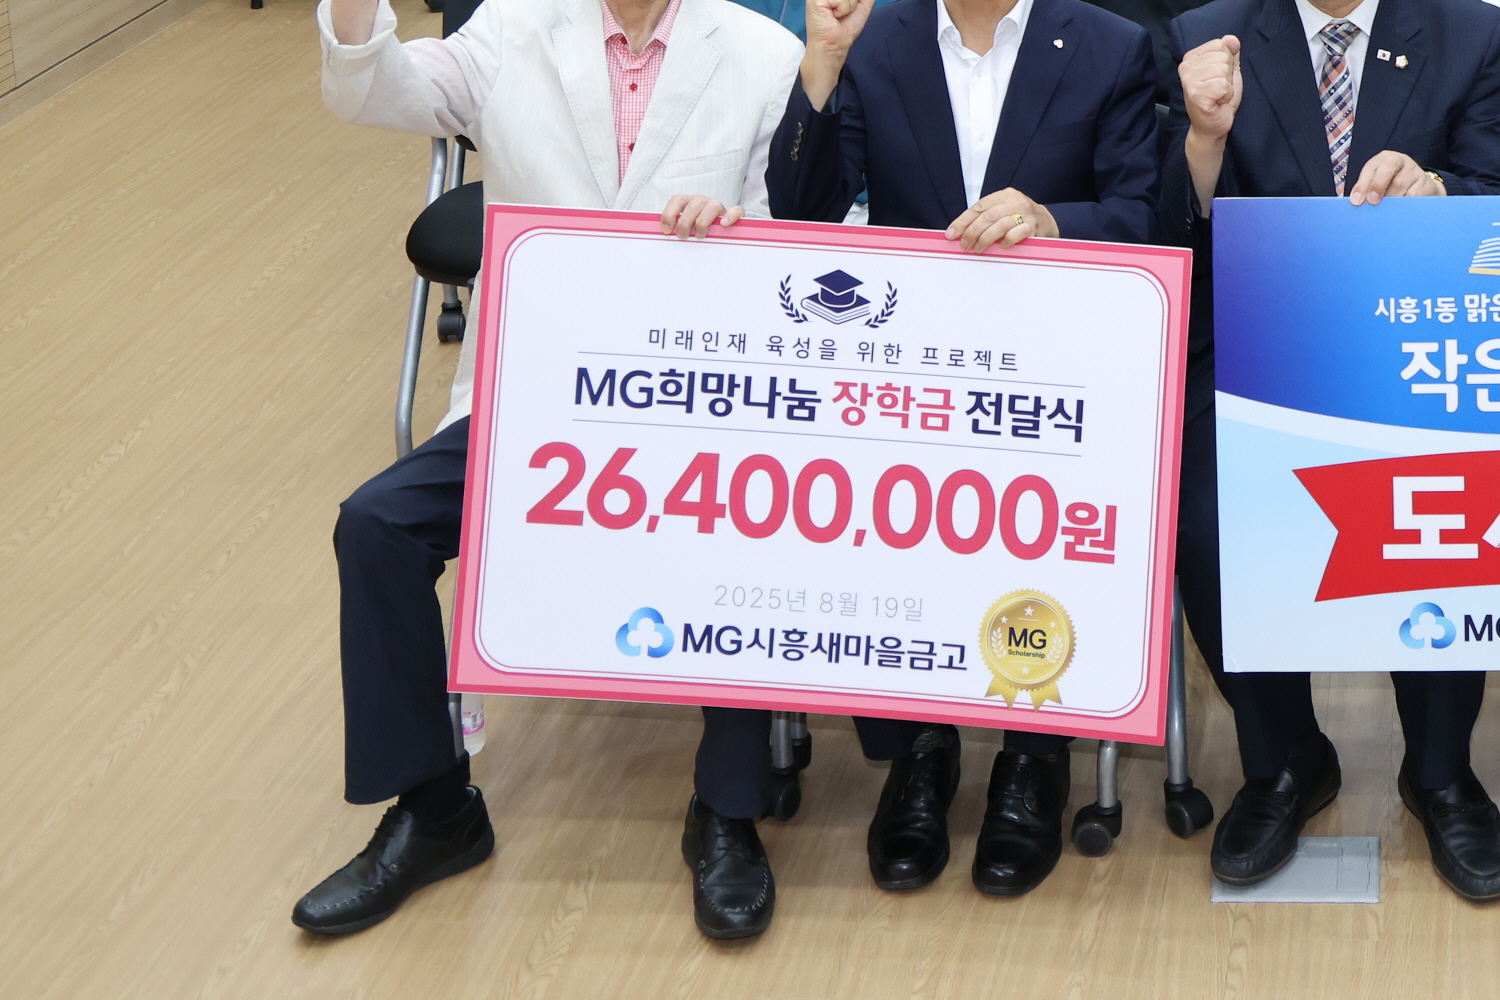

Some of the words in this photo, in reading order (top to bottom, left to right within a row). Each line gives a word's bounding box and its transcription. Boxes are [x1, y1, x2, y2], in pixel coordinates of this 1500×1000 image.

[1375, 297, 1458, 323] 시흥1동
[649, 328, 746, 355] 미래인재
[765, 335, 837, 361] 육성을
[857, 341, 902, 365] 위한
[920, 347, 1018, 372] 프로젝트
[574, 367, 822, 422] MG희망나눔
[832, 381, 956, 432] 장학금
[965, 391, 1085, 443] 전달식
[526, 441, 1117, 565] 26,400,000원
[714, 585, 806, 613] 2025년
[819, 592, 858, 617] 8월
[872, 596, 923, 622] 19일
[682, 623, 968, 671] MG시흥새마을금고
[1007, 626, 1047, 650] MG
[1007, 648, 1046, 660] Scholarship
